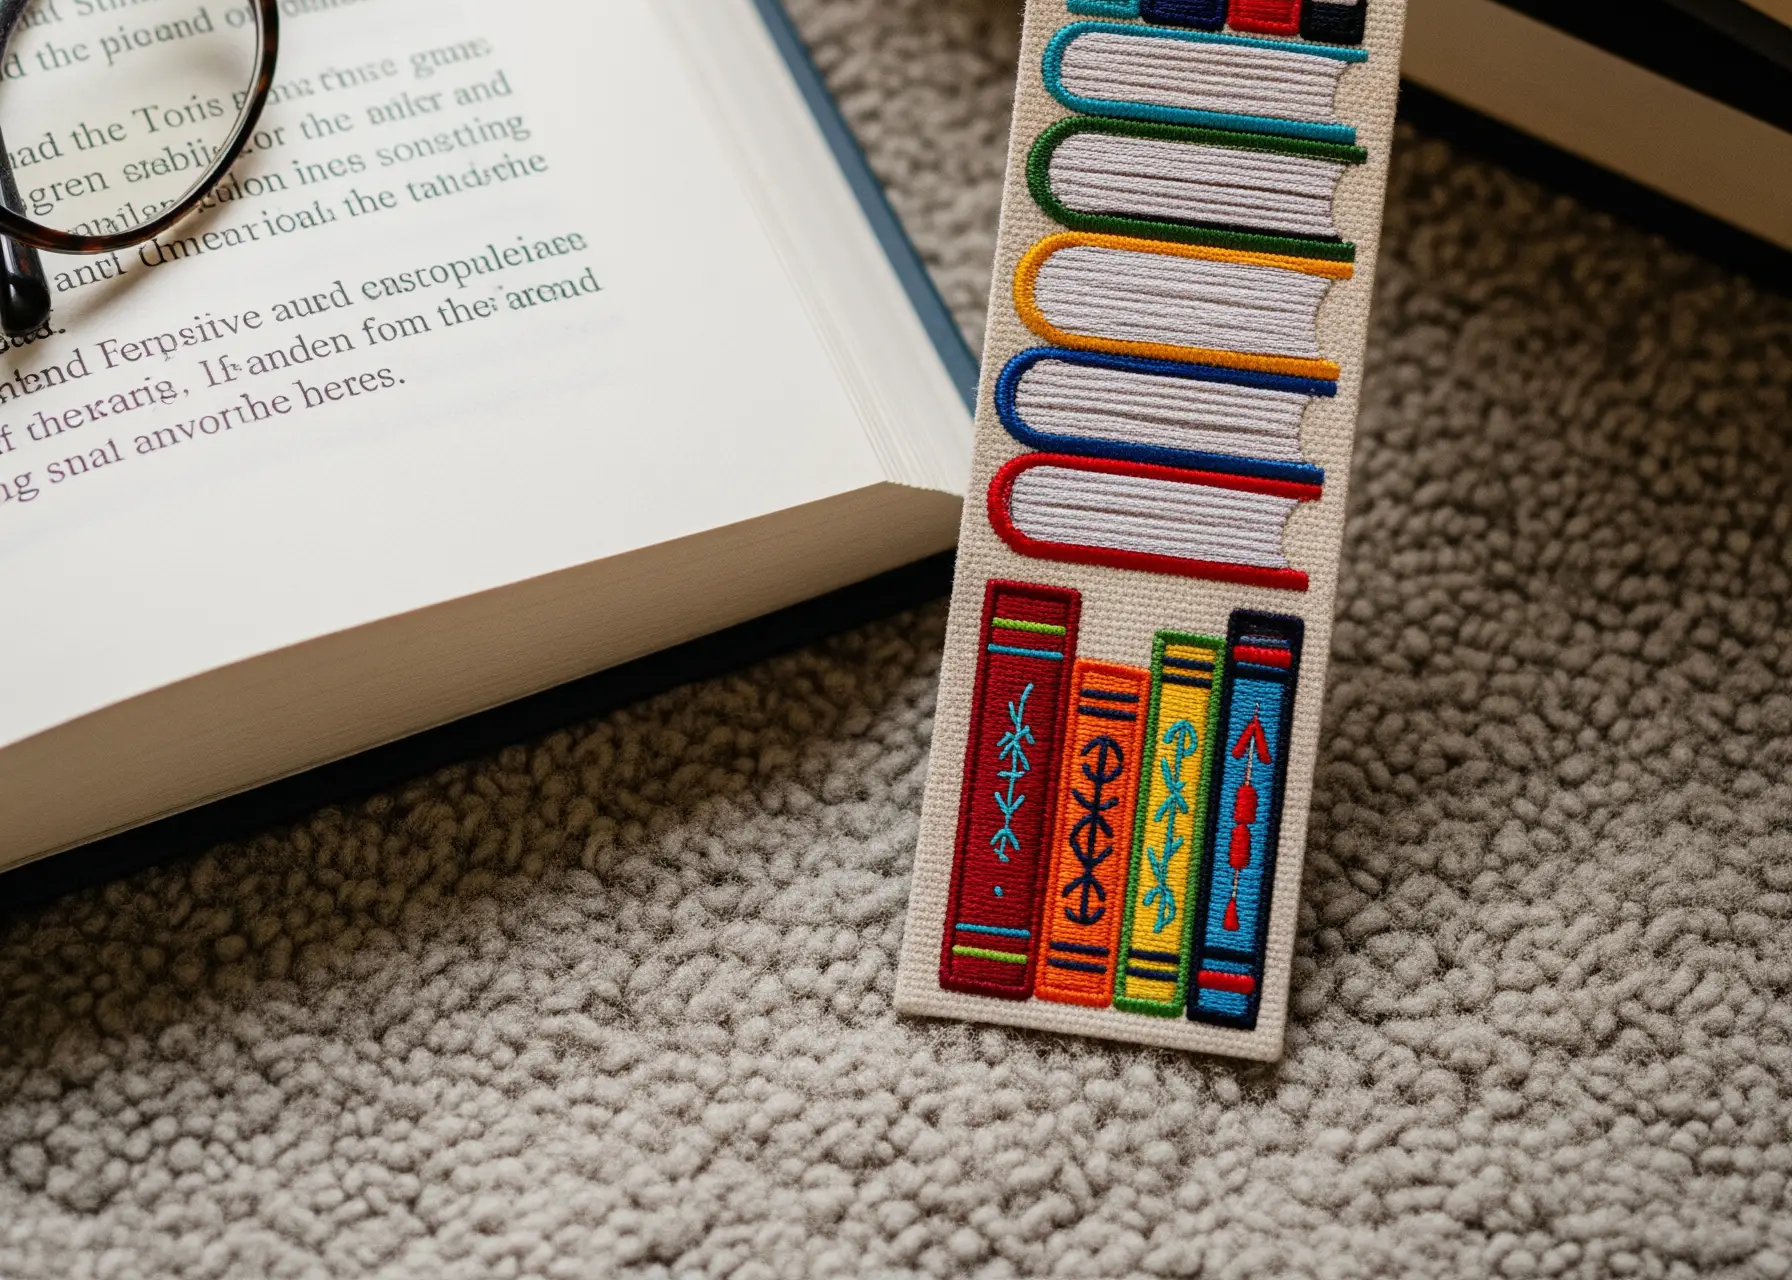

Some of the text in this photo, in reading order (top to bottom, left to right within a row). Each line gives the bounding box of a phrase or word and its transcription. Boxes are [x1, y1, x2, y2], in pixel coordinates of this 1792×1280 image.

[300, 110, 354, 142] the
[453, 67, 514, 107] and
[70, 121, 128, 151] the
[342, 185, 398, 218] the
